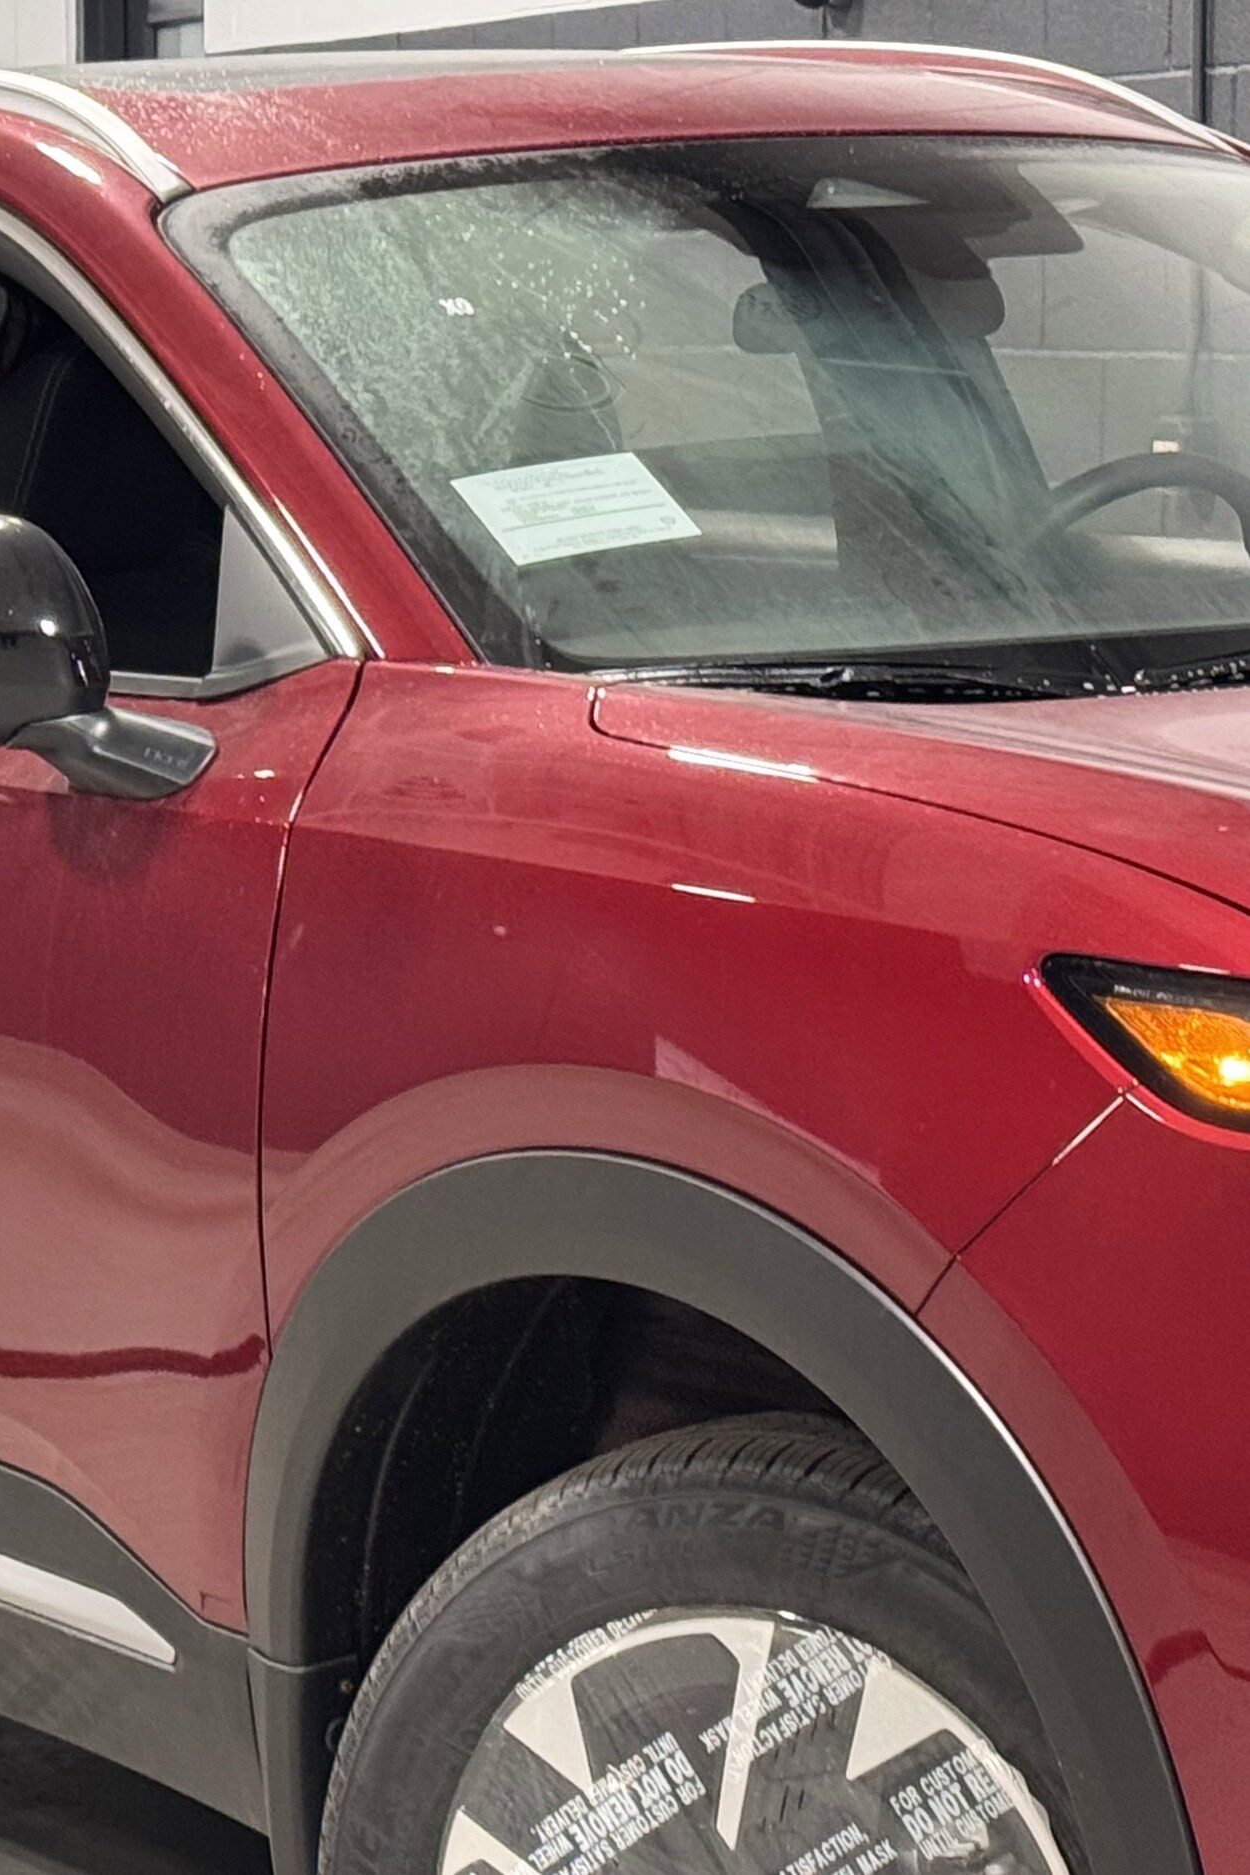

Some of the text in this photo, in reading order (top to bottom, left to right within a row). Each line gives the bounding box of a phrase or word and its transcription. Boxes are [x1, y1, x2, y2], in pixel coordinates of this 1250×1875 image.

[777, 1645, 852, 1707] REMOVE
[642, 1731, 677, 1764] UNTIL
[665, 1750, 695, 1784] DO
[631, 1765, 672, 1807] NOT
[676, 1774, 707, 1806] FOR
[889, 1748, 979, 1816] FOR CUSTOM
[568, 1785, 640, 1852] REMOVE
[610, 1794, 679, 1851] CUSTOMER
[902, 1806, 934, 1844] DO
[928, 1781, 971, 1826] NOT
[528, 1832, 574, 1872] WHEEL
[856, 1838, 899, 1875] MASK
